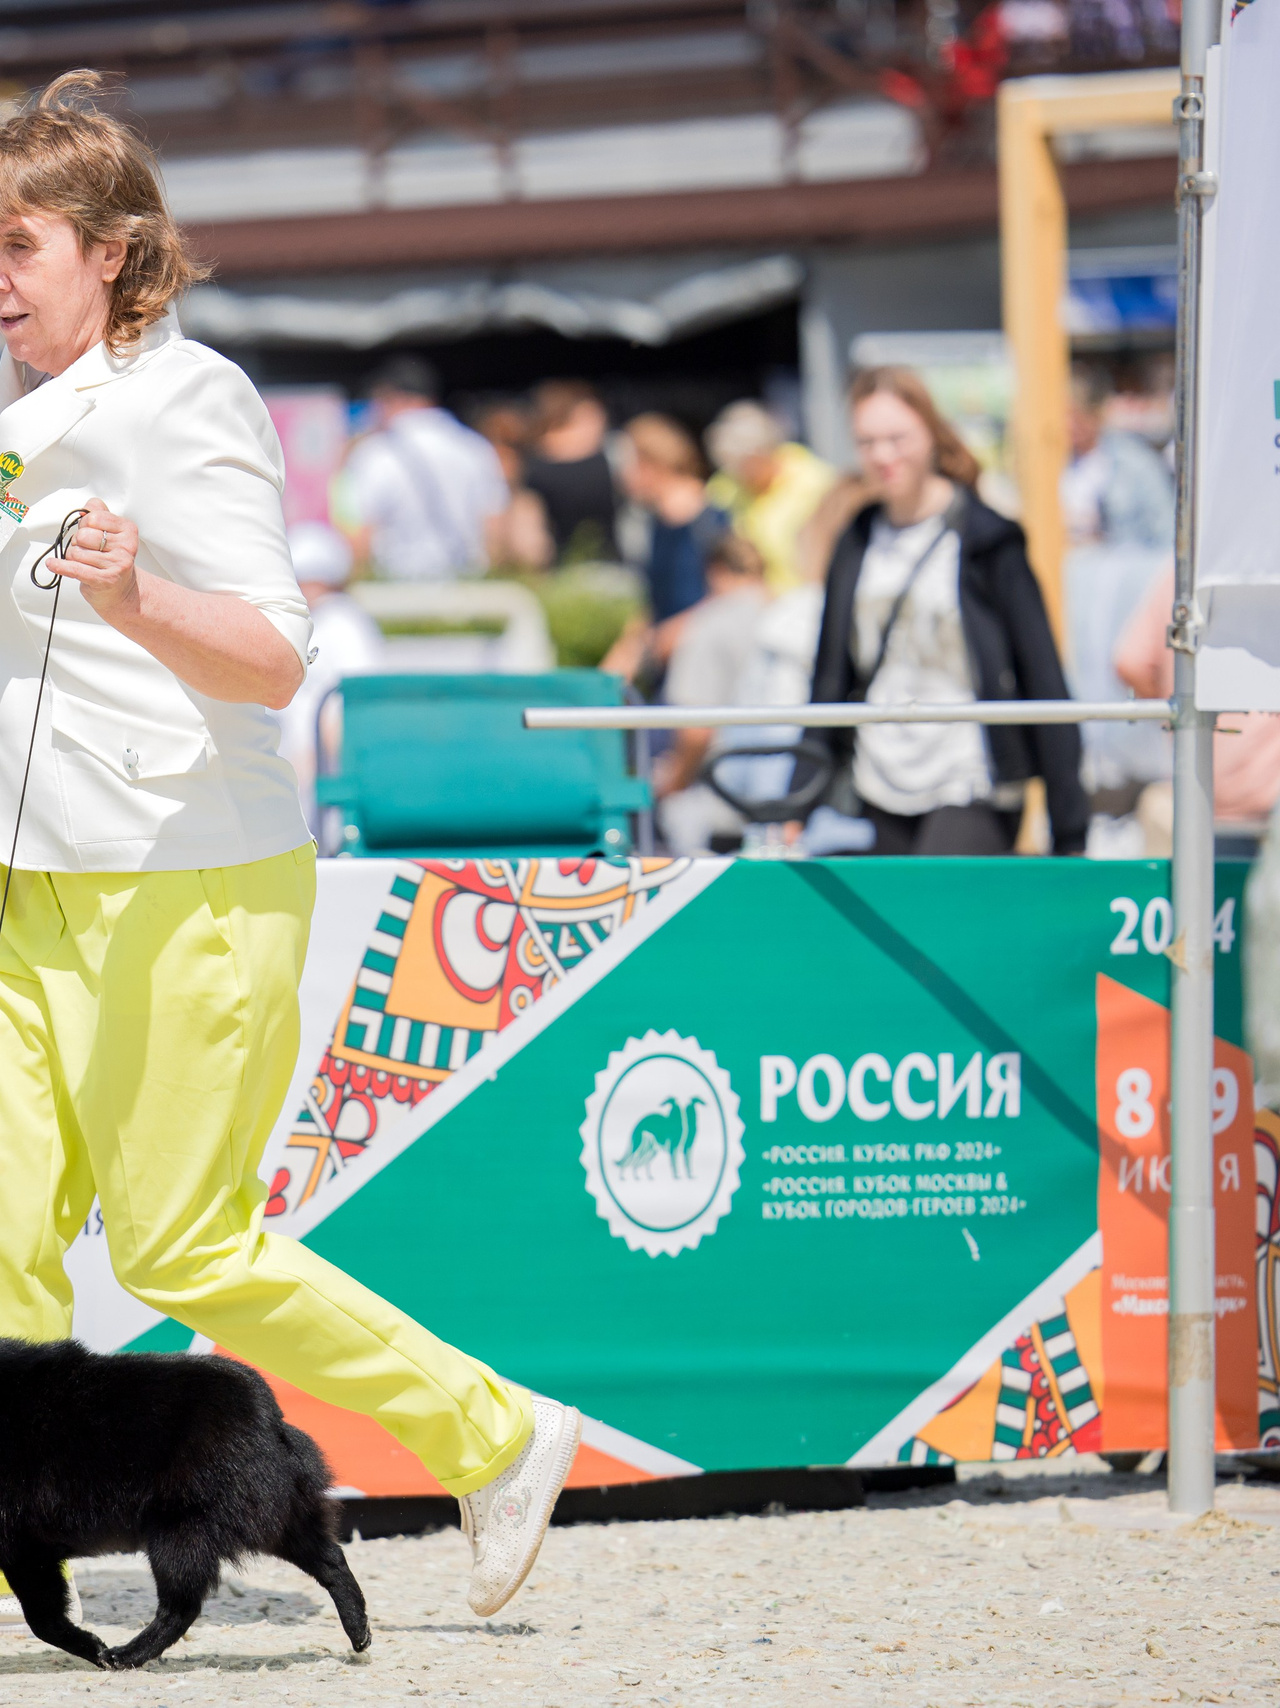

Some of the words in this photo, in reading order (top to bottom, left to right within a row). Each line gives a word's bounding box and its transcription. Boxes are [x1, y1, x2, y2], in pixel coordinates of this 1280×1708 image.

[1109, 896, 1236, 956] 204
[759, 1051, 1021, 1124] РОССИЯ
[1117, 1153, 1241, 1194] ИЮЯ
